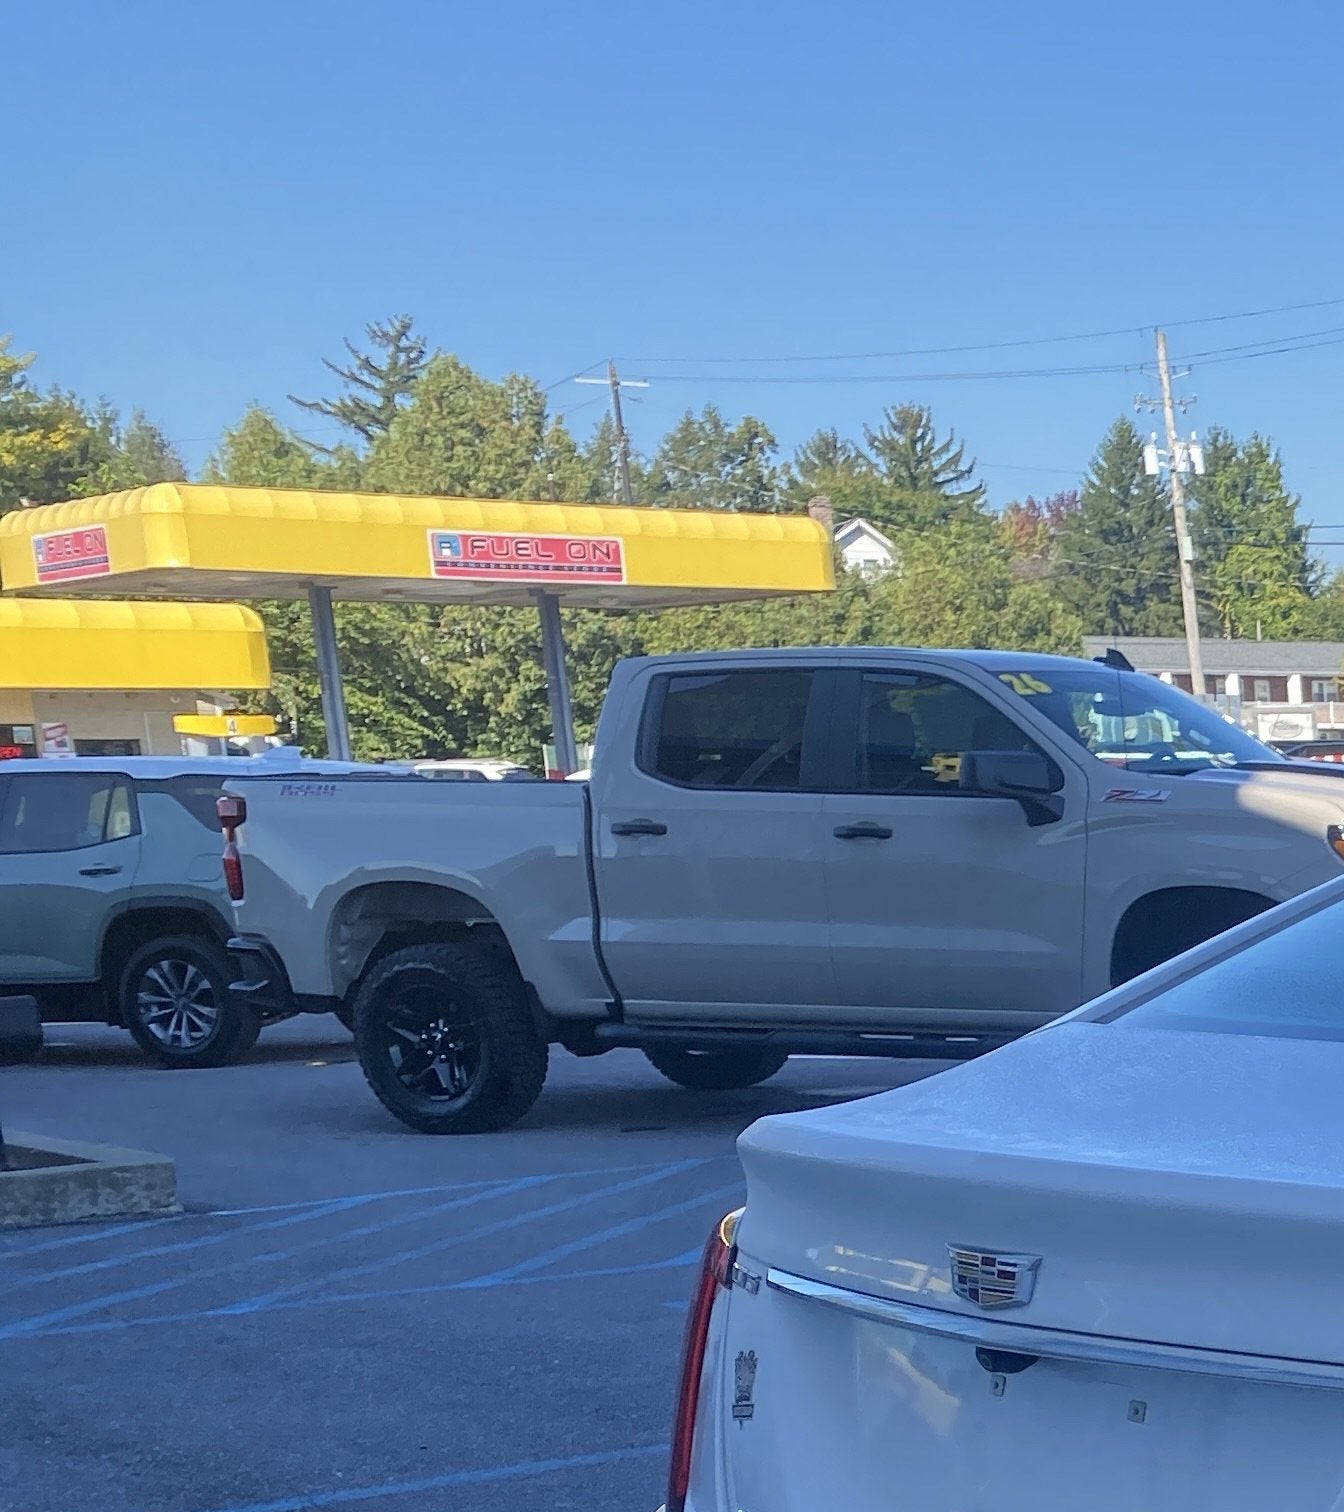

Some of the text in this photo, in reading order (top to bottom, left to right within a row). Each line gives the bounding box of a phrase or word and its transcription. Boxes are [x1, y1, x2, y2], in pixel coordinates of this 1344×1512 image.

[468, 537, 612, 561] FUEL ON
[998, 673, 1053, 696] 26
[228, 720, 237, 732] 4
